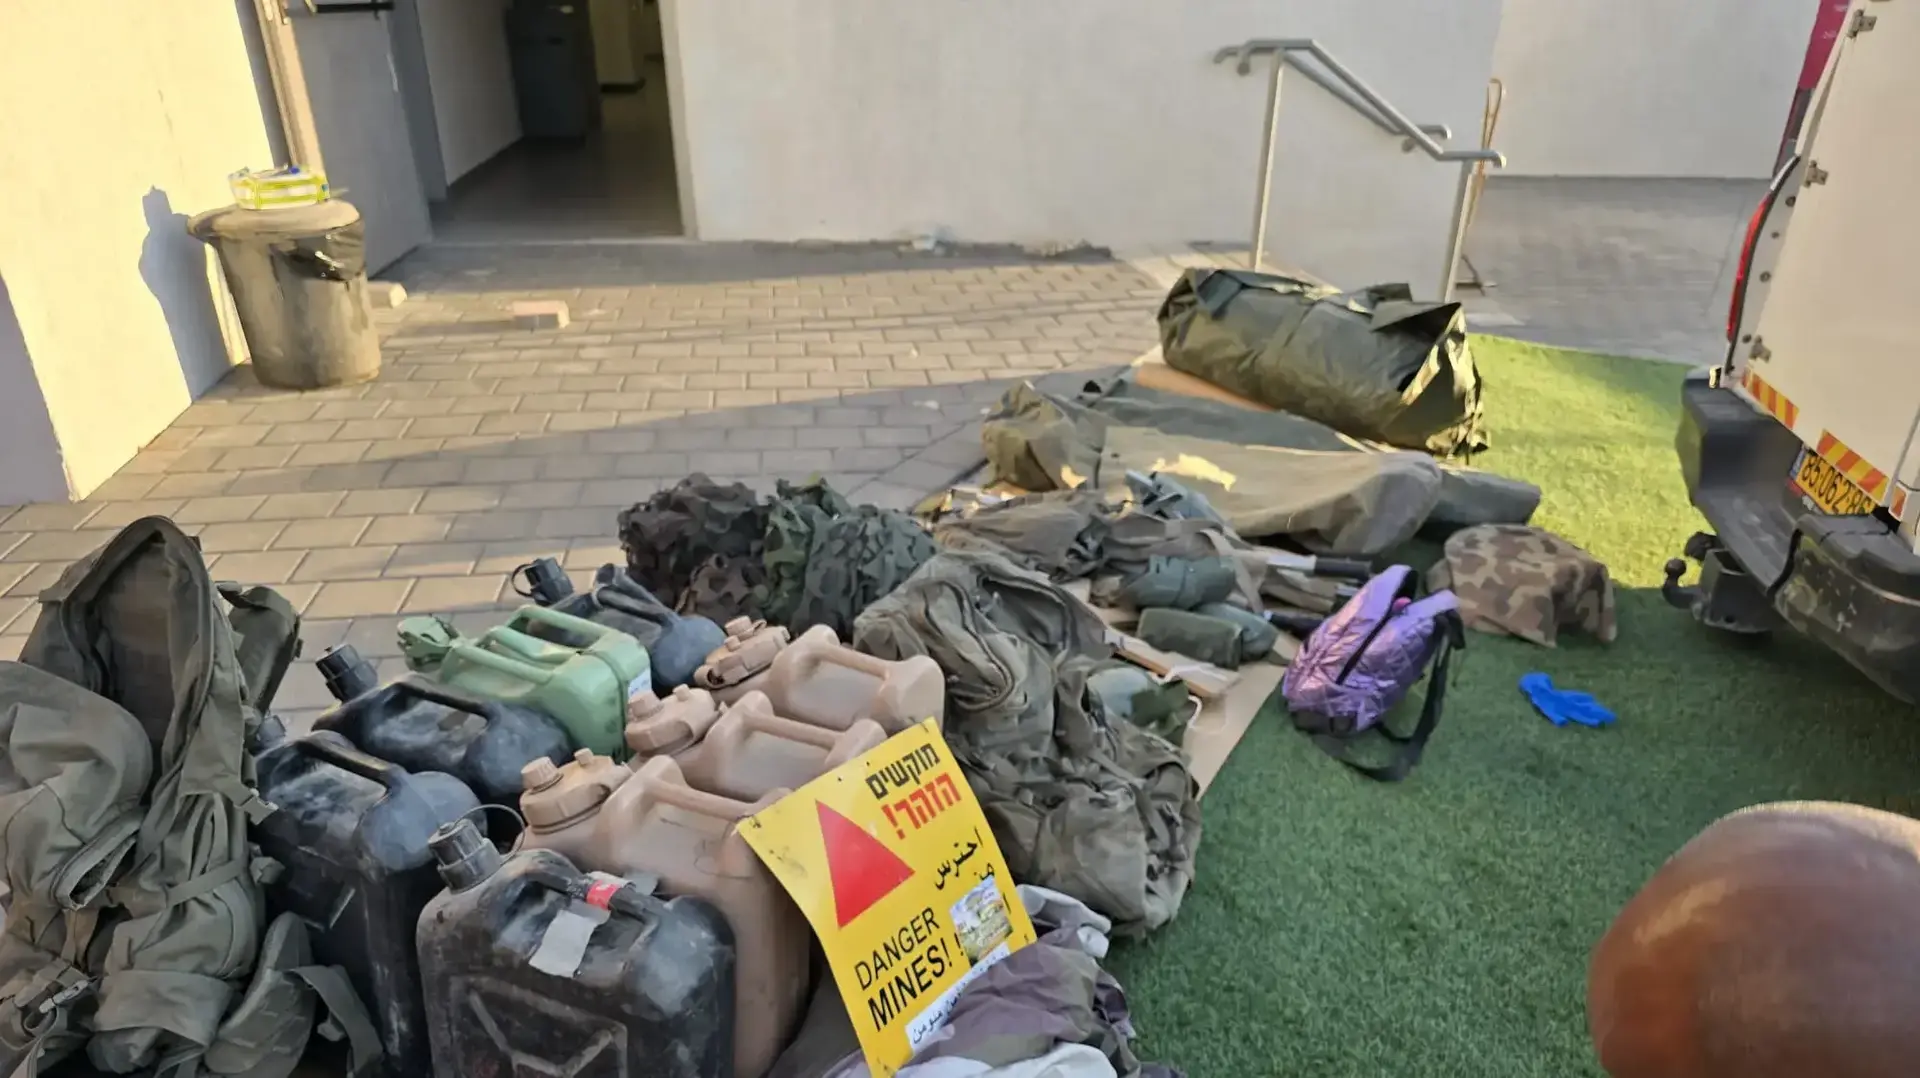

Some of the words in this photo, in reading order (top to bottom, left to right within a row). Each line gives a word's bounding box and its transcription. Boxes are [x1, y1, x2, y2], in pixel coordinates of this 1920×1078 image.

[866, 743, 940, 800] מוקשים
[881, 772, 962, 840] הזהר!
[854, 907, 940, 991] DANGER
[868, 937, 952, 1032] MINES!
